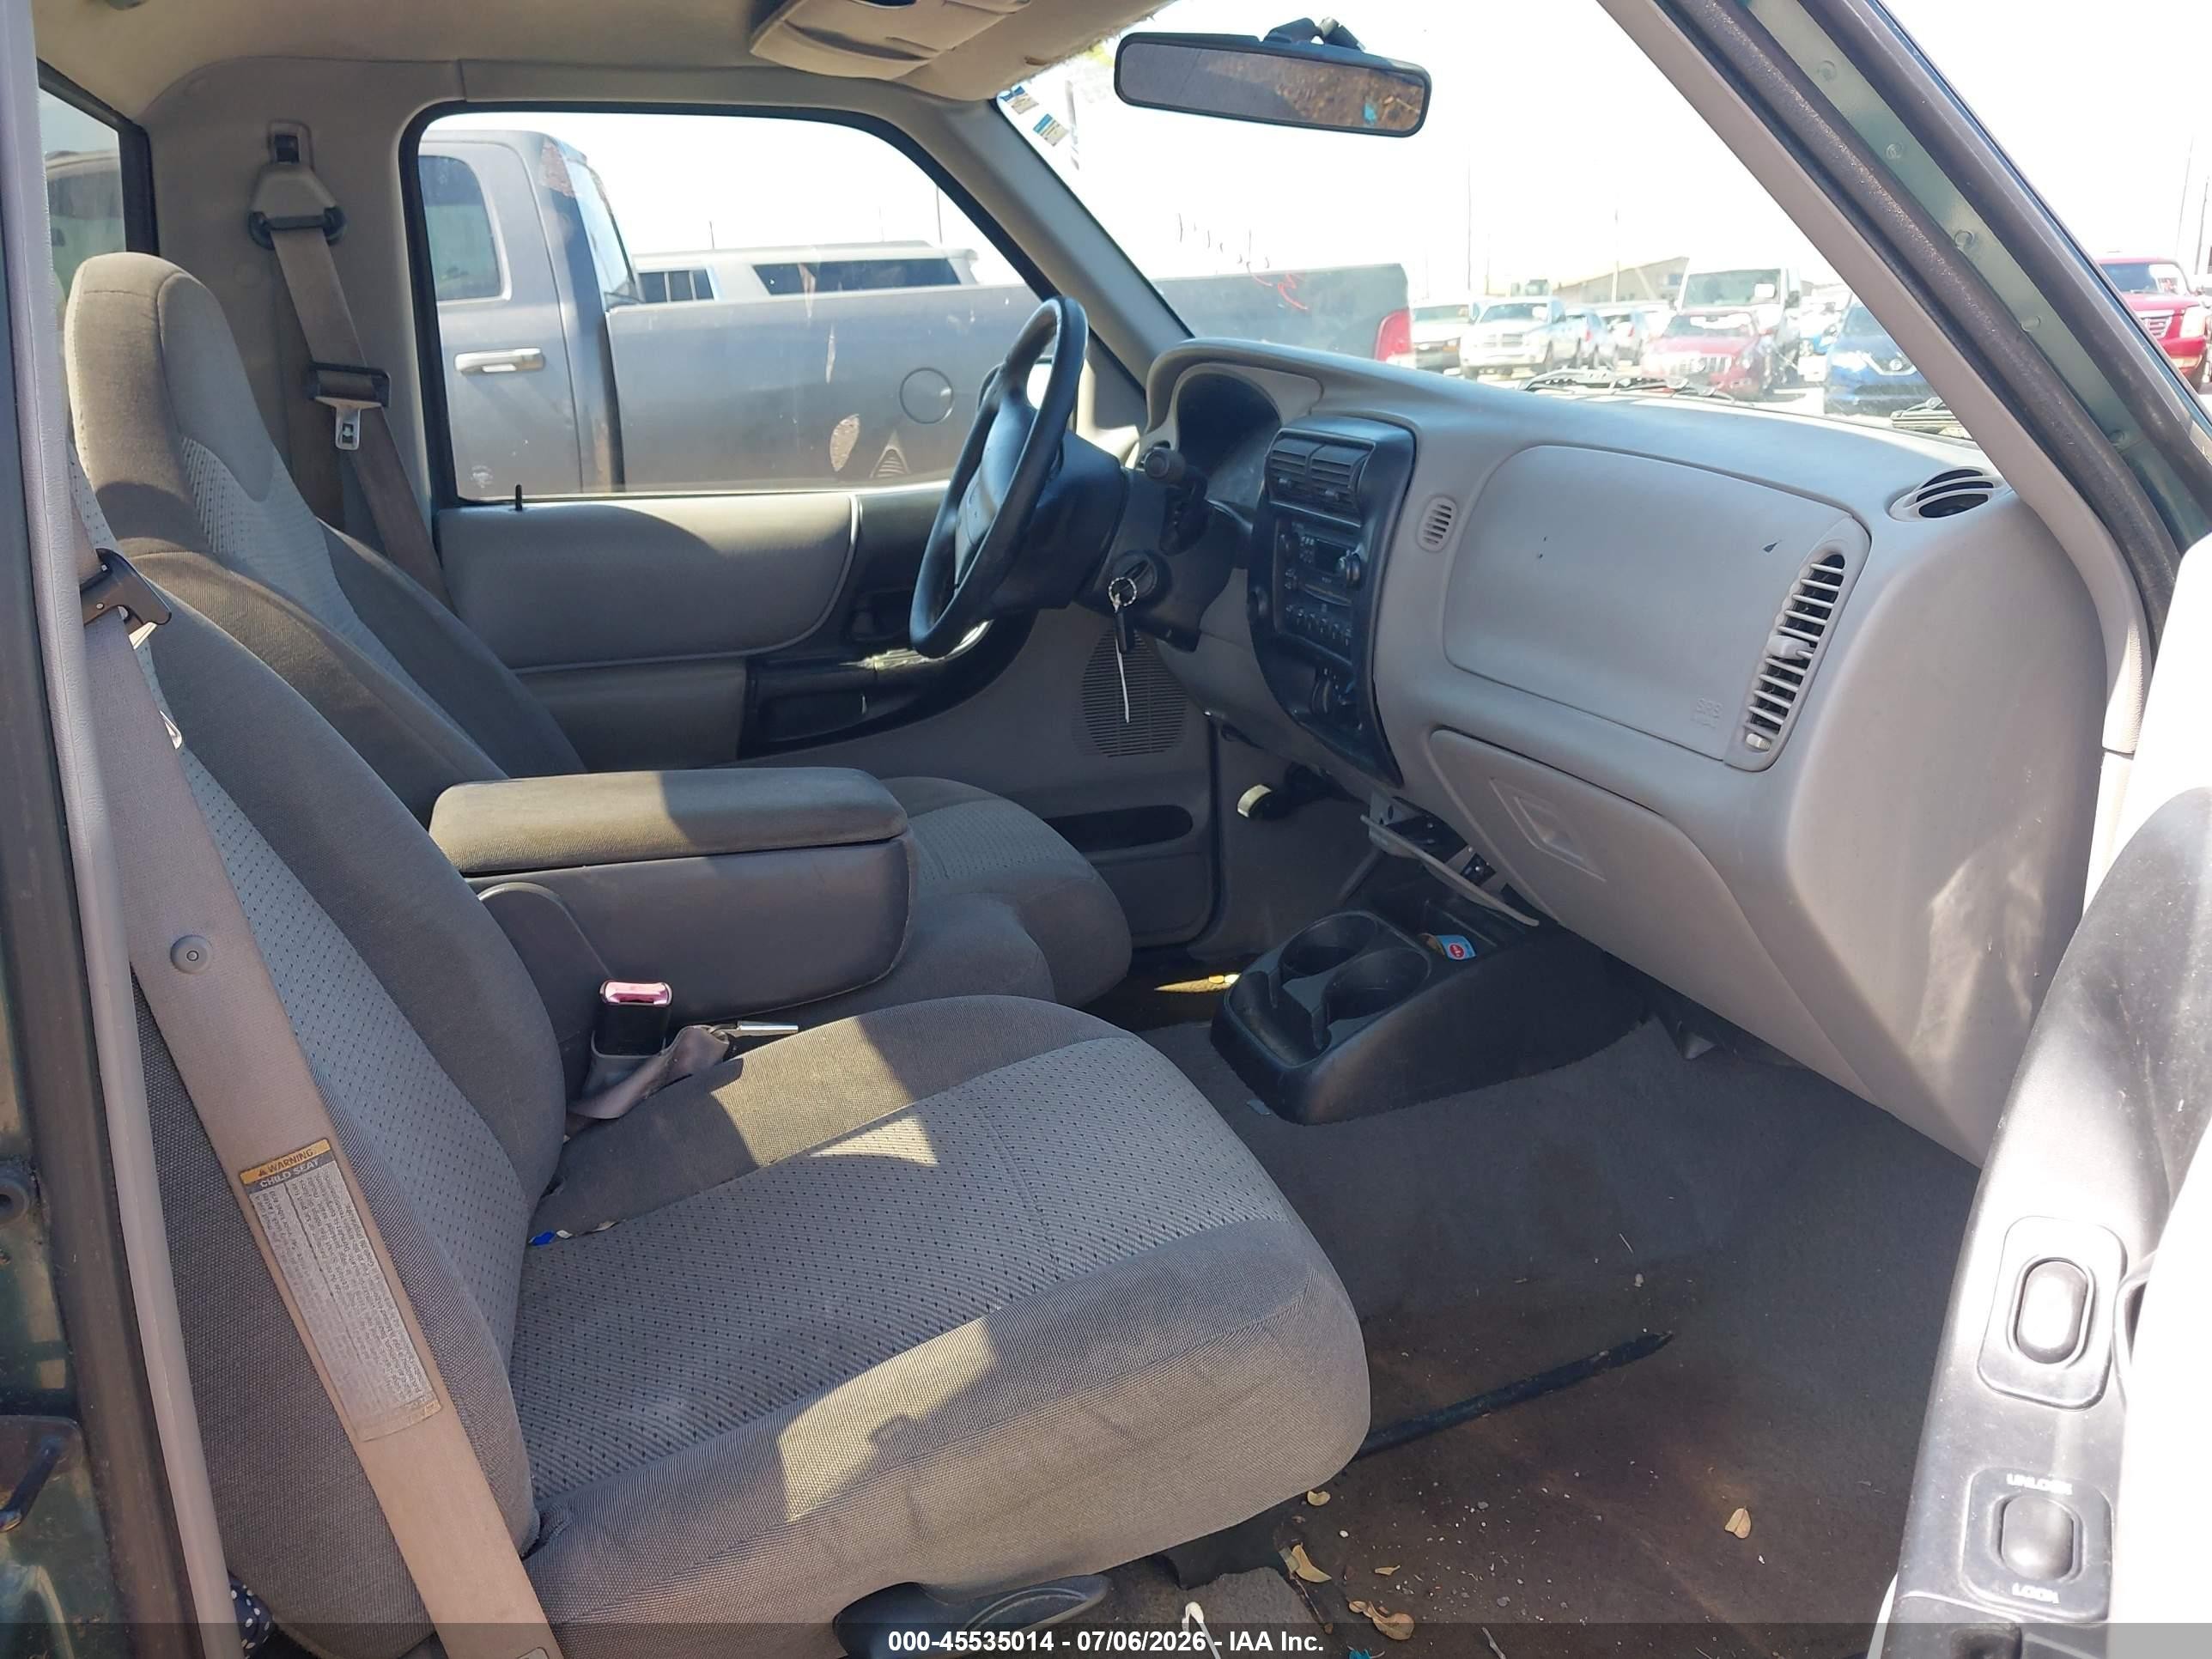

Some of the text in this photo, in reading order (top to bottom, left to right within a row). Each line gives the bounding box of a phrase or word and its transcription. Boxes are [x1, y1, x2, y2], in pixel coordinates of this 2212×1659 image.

[260, 1159, 320, 1188] CHILD SEAT
[267, 1149, 313, 1173] WARNING
